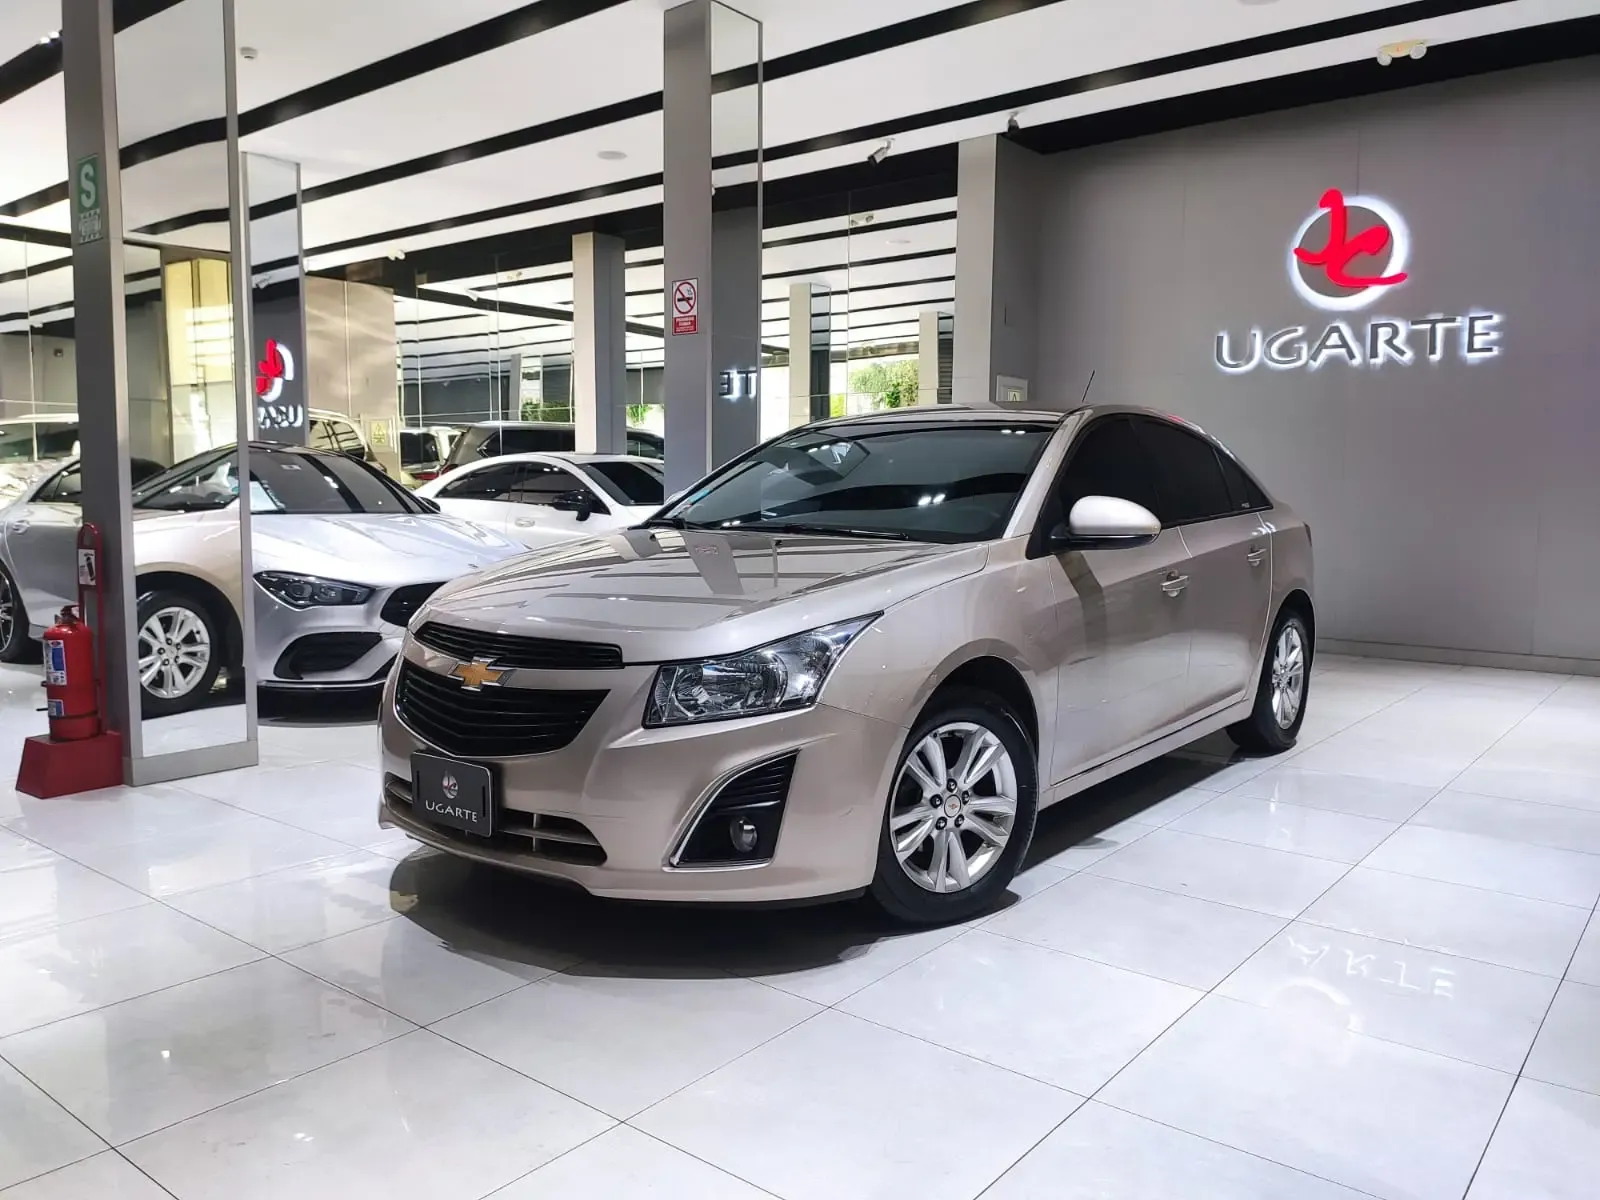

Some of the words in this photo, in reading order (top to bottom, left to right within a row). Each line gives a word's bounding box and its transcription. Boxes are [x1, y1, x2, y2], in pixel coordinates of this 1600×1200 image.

[80, 163, 96, 208] S
[1214, 312, 1503, 371] UGARTE
[425, 799, 478, 823] UGARTE
